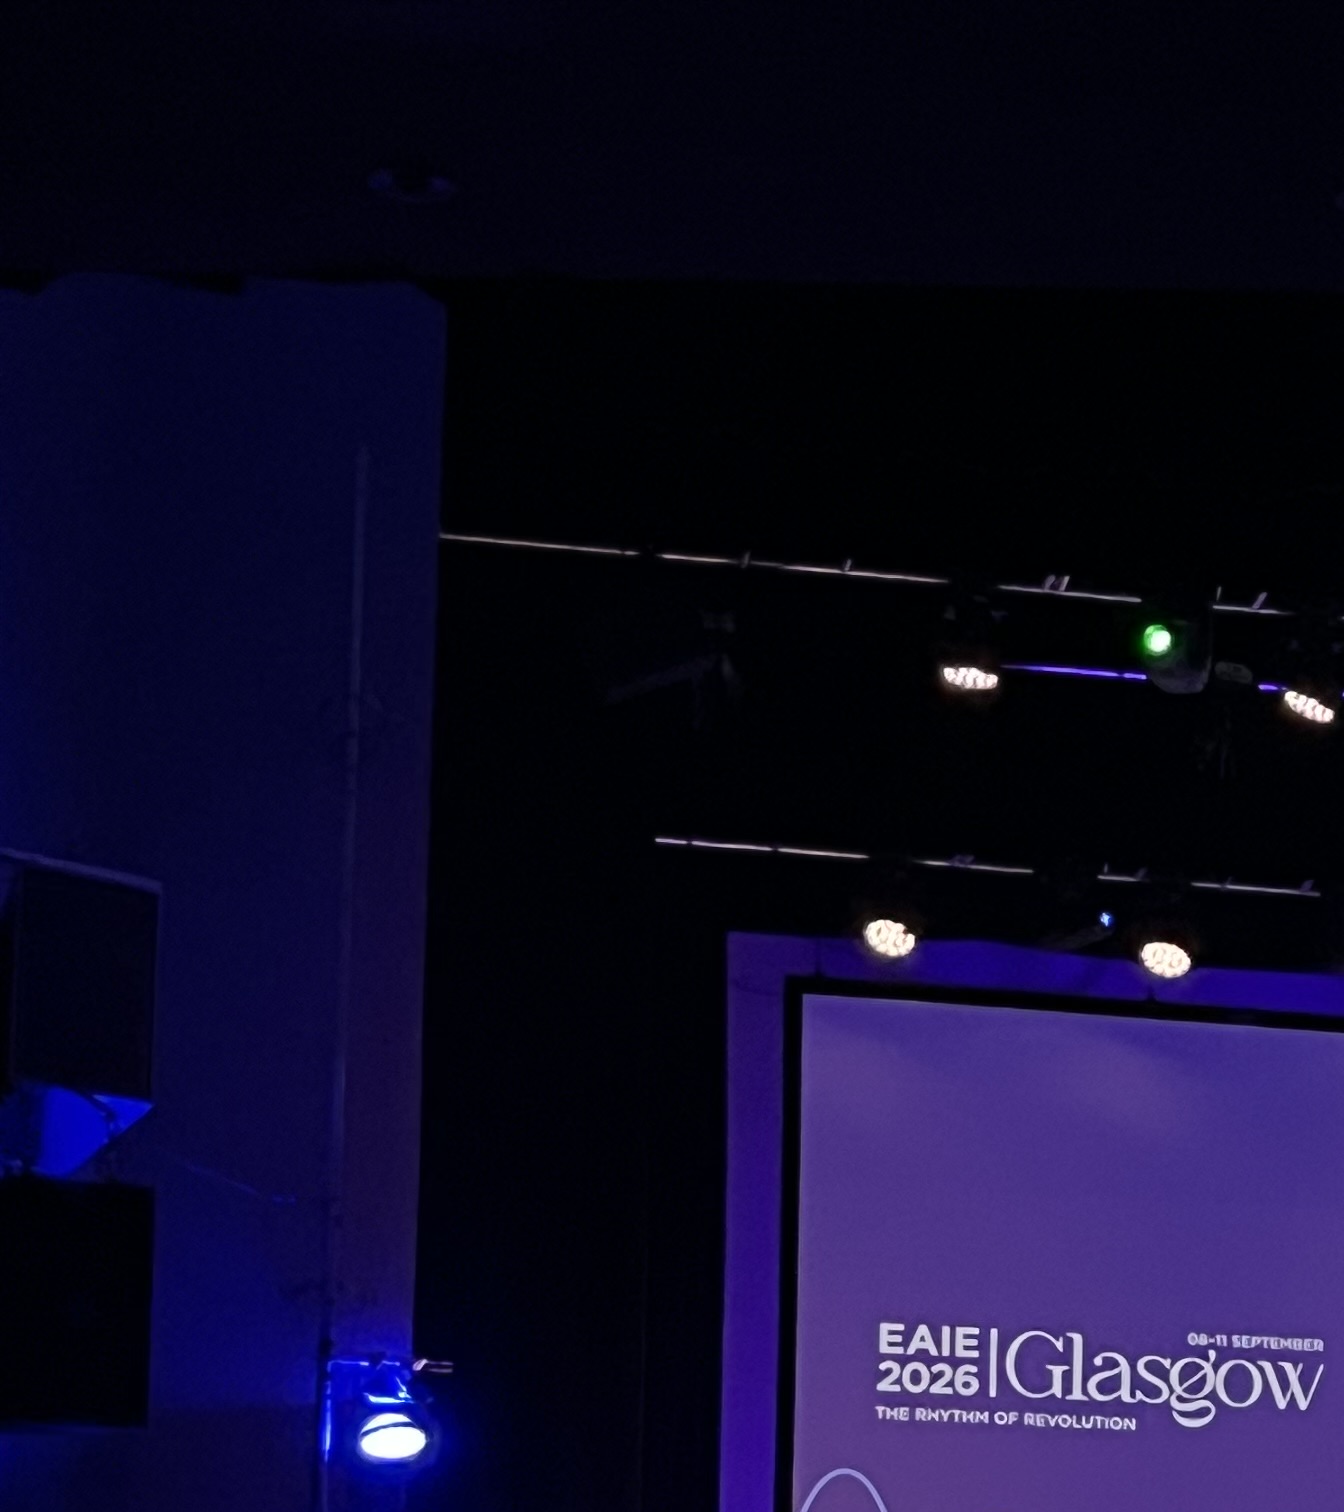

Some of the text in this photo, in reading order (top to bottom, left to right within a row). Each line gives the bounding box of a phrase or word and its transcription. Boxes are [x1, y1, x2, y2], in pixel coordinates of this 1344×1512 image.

[878, 1322, 980, 1358] EAIE
[1231, 1334, 1324, 1352] SEPTEMBER
[875, 1359, 980, 1397] 2026
[1005, 1330, 1324, 1428] Glasgow
[874, 1405, 1137, 1431] THE RHYTHM OF REVOLUTION
